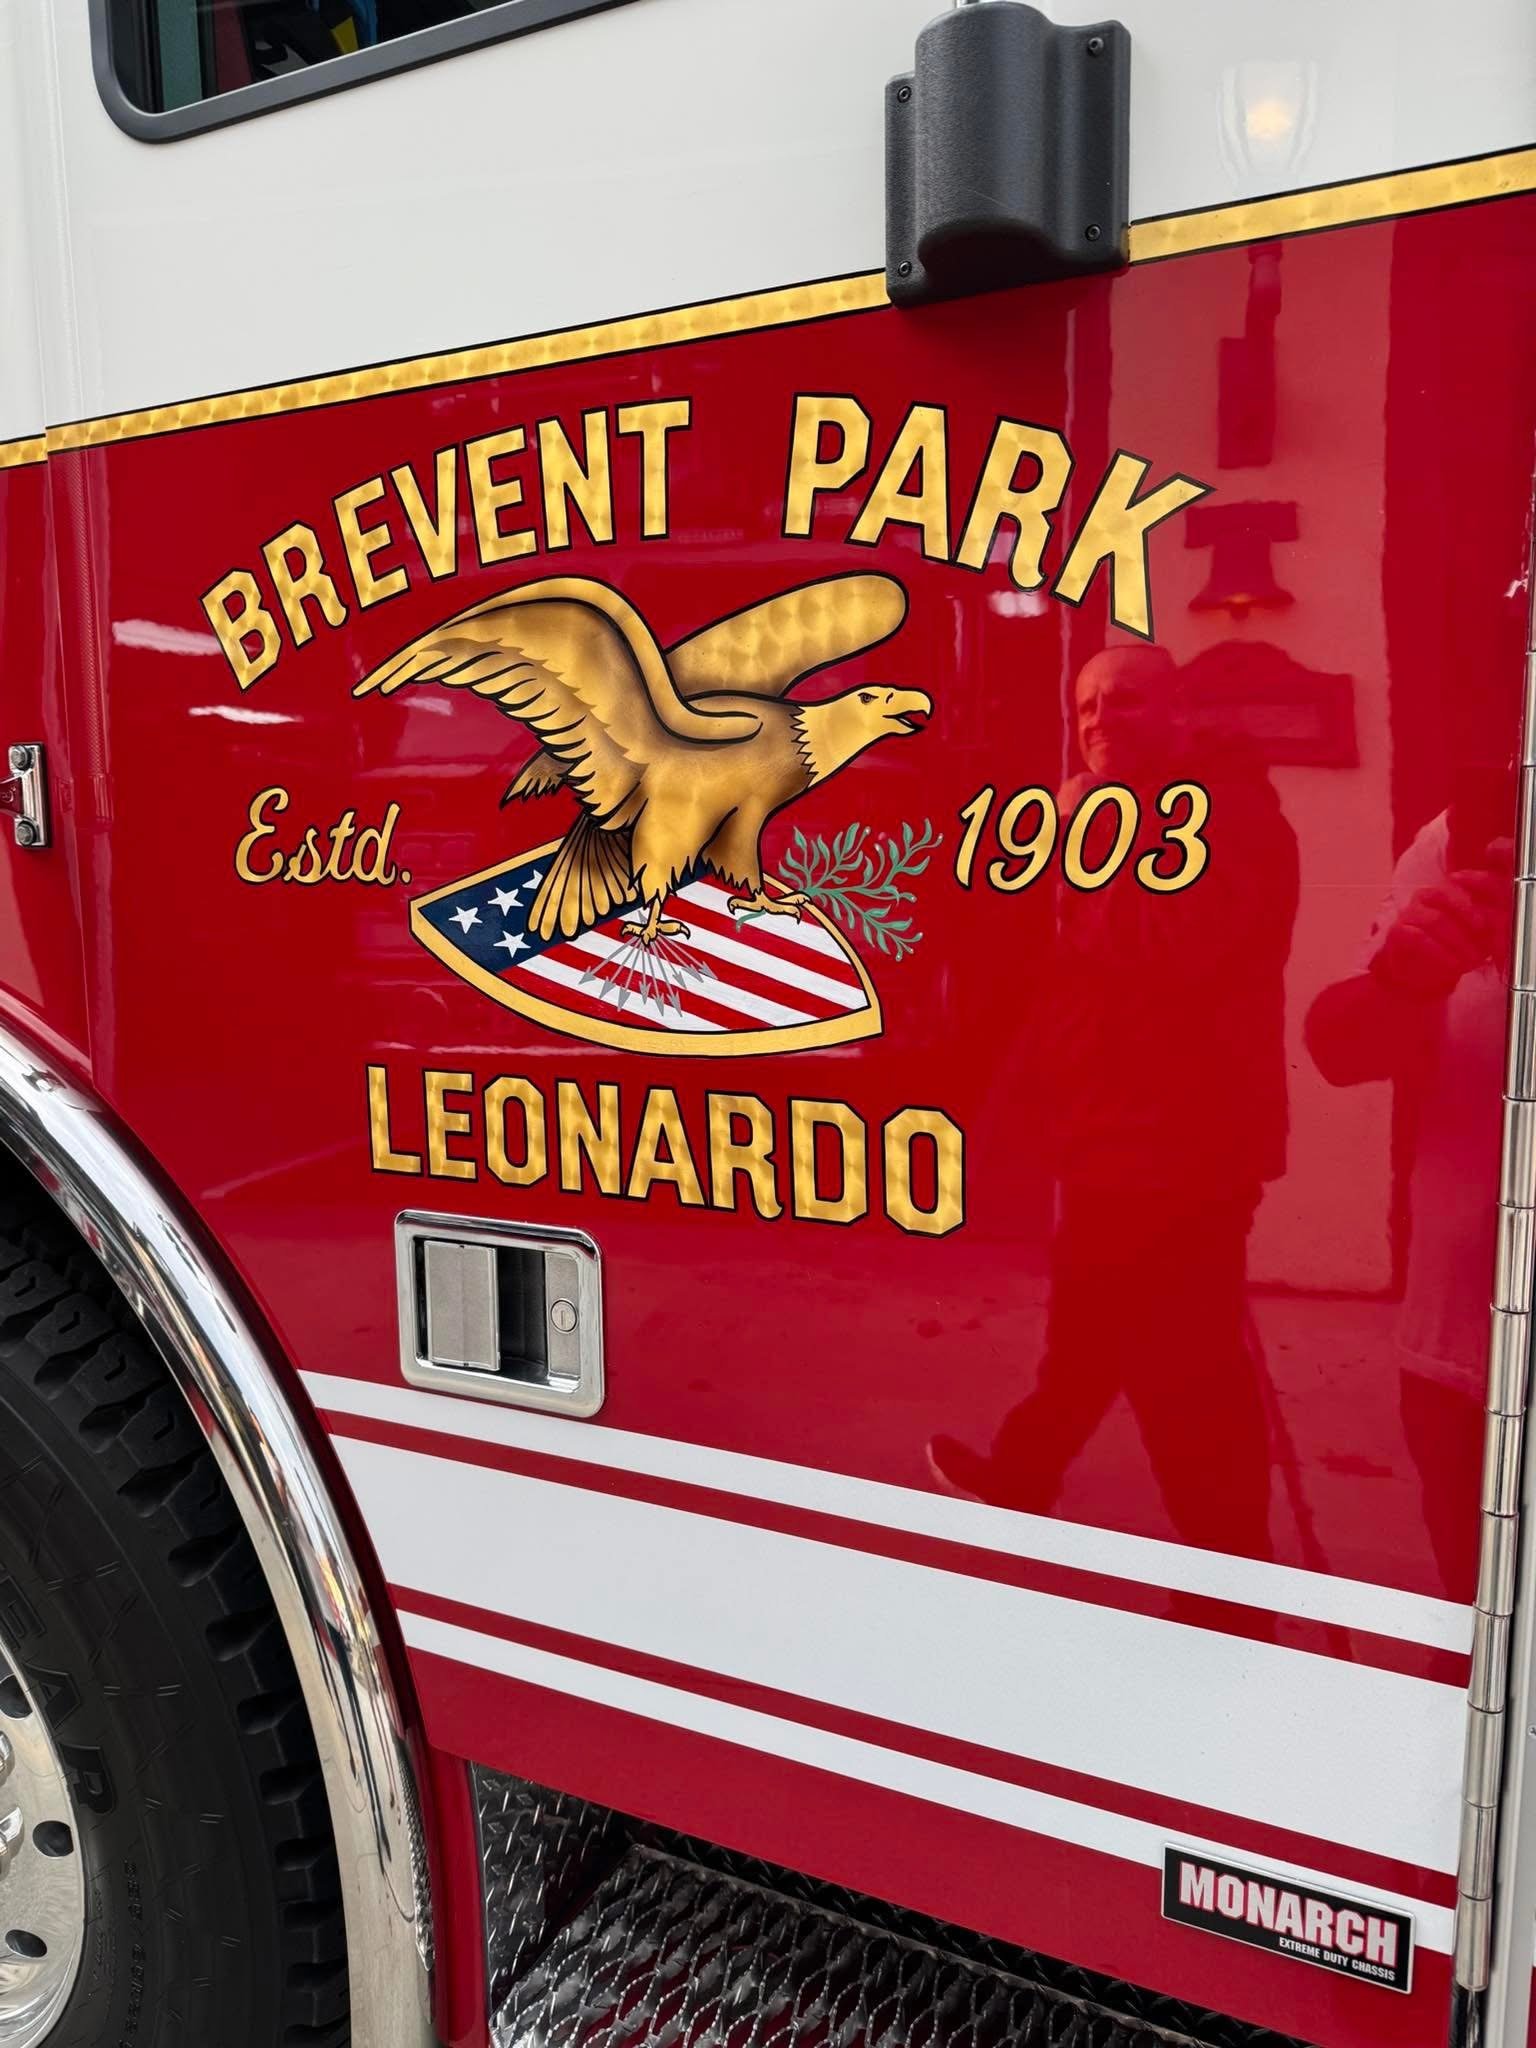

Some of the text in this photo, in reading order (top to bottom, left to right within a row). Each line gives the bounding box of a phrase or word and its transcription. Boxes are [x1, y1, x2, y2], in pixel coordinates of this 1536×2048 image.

[200, 392, 1217, 693] BREVENT PARK
[233, 779, 1213, 895] Estd. 1903
[365, 1063, 968, 1239] LEONARDO
[1179, 1860, 1399, 1968] MONARCH
[1279, 1936, 1396, 1982] EXTREME DUTY CHASSIS
